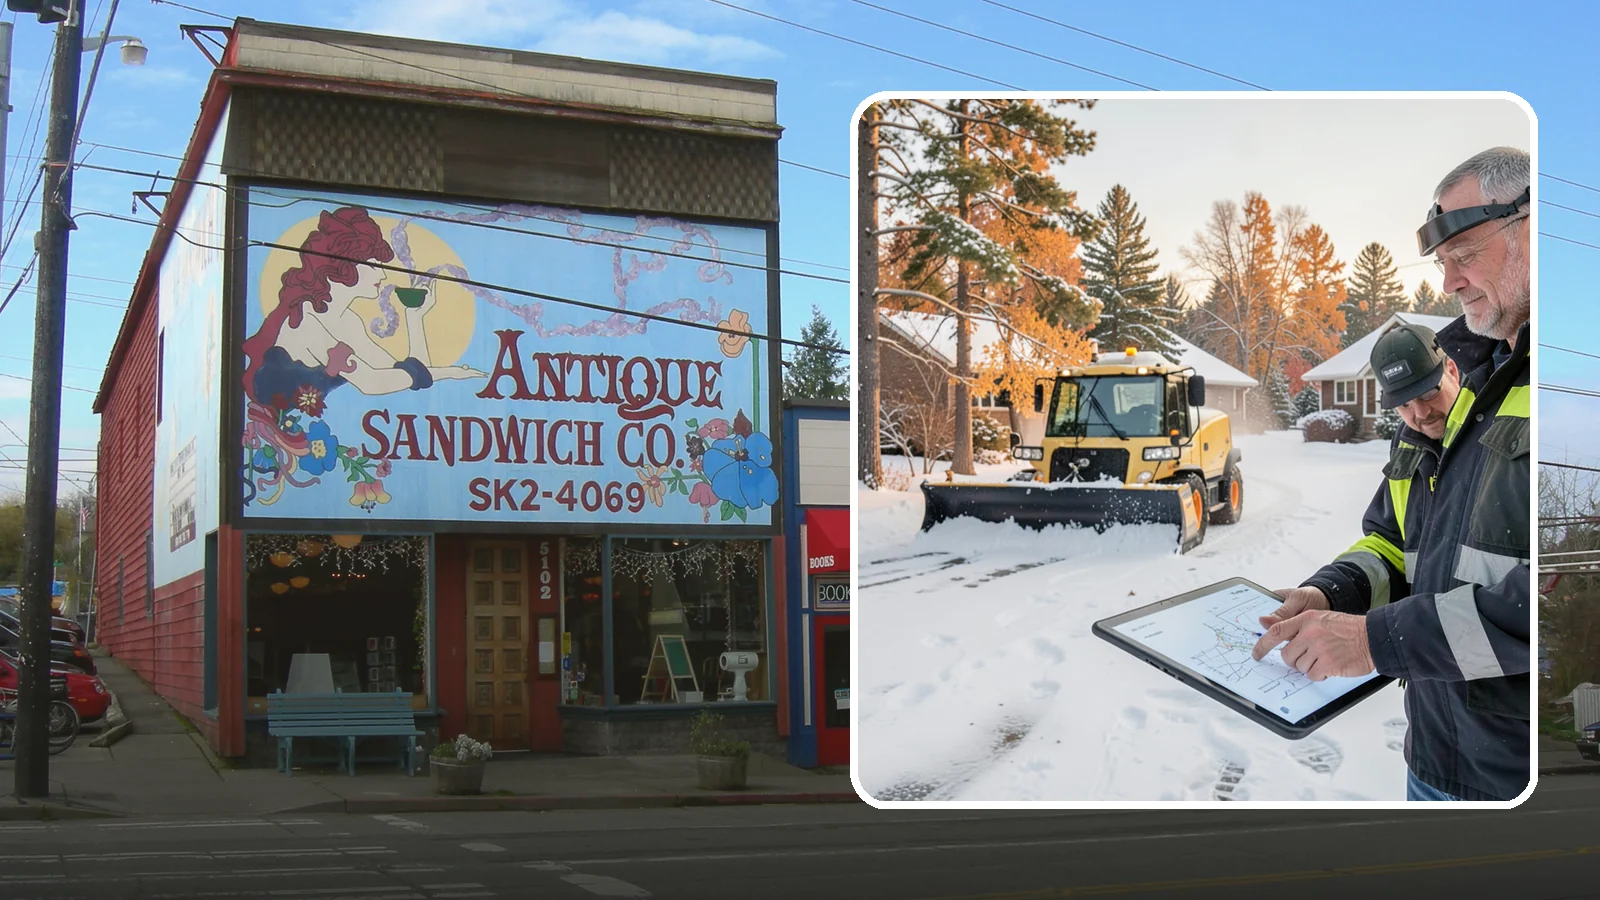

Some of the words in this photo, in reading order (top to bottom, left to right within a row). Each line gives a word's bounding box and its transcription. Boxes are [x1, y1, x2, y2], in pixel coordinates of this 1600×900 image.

[475, 328, 723, 421] ANTIQUE
[361, 408, 604, 467] SANDWICH
[617, 421, 684, 469] CO.
[468, 477, 645, 513] SK2-4069
[540, 541, 551, 600] 5102
[809, 555, 835, 569] BOOKS
